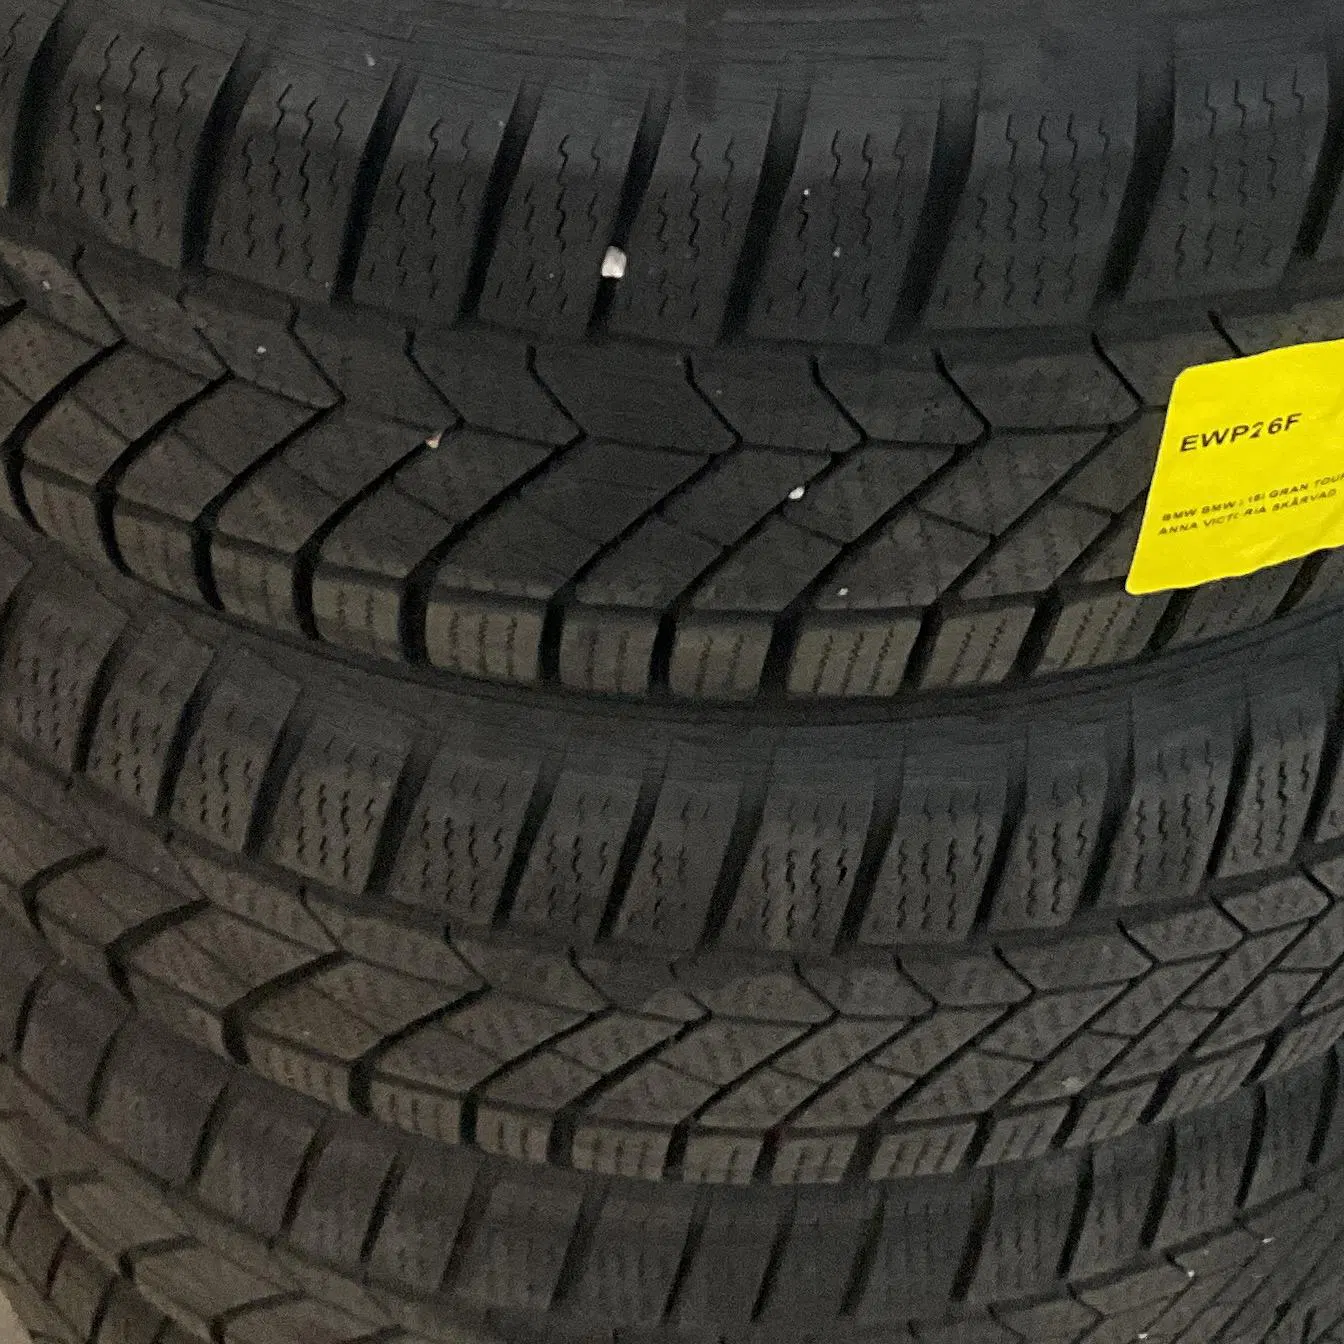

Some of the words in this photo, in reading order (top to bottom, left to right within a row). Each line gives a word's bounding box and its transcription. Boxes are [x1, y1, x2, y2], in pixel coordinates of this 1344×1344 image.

[1179, 411, 1304, 453] EWP26F
[1162, 508, 1197, 522] BMW
[1201, 500, 1237, 515] BMW
[1268, 482, 1309, 498] GRAN
[1158, 522, 1198, 536] ANNA
